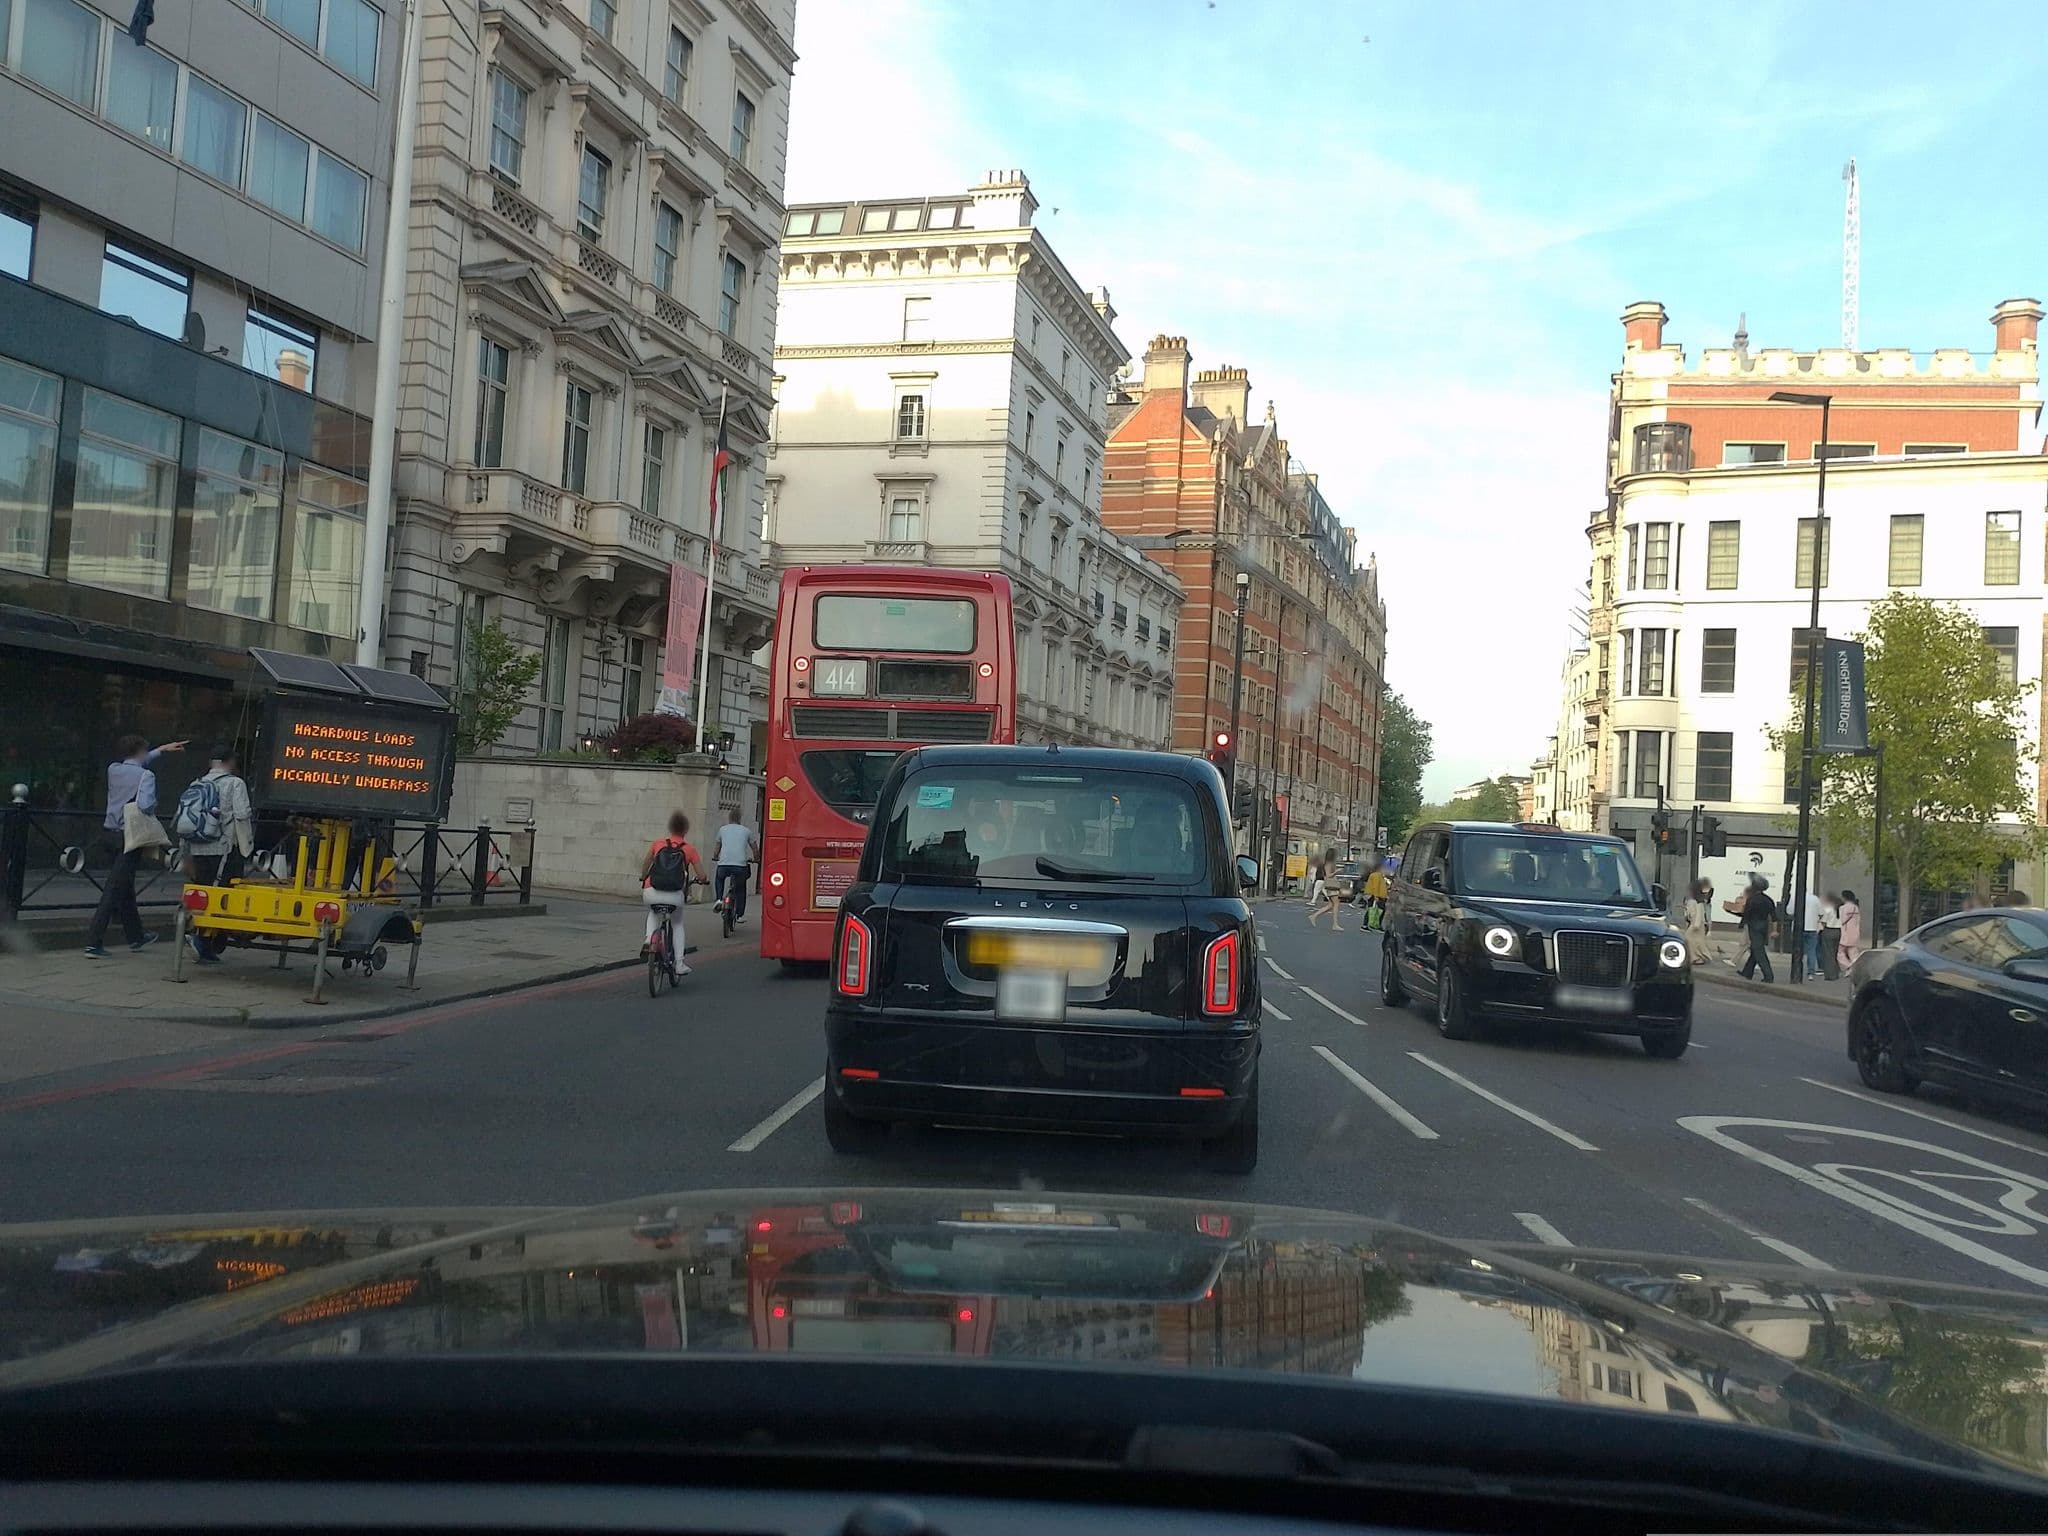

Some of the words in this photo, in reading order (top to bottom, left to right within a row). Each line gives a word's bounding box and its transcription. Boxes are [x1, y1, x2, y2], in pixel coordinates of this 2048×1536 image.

[825, 665, 857, 691] 414
[294, 723, 369, 742] HAZARDOUS
[374, 732, 415, 747] LOADS
[285, 745, 305, 758] NO
[310, 748, 361, 763] ACCESS
[367, 754, 424, 770] THROUGH
[274, 768, 350, 785] PICCADILLY
[355, 775, 430, 793] UNDERPASS
[994, 900, 1079, 910] LEVC
[903, 983, 930, 992] TX
